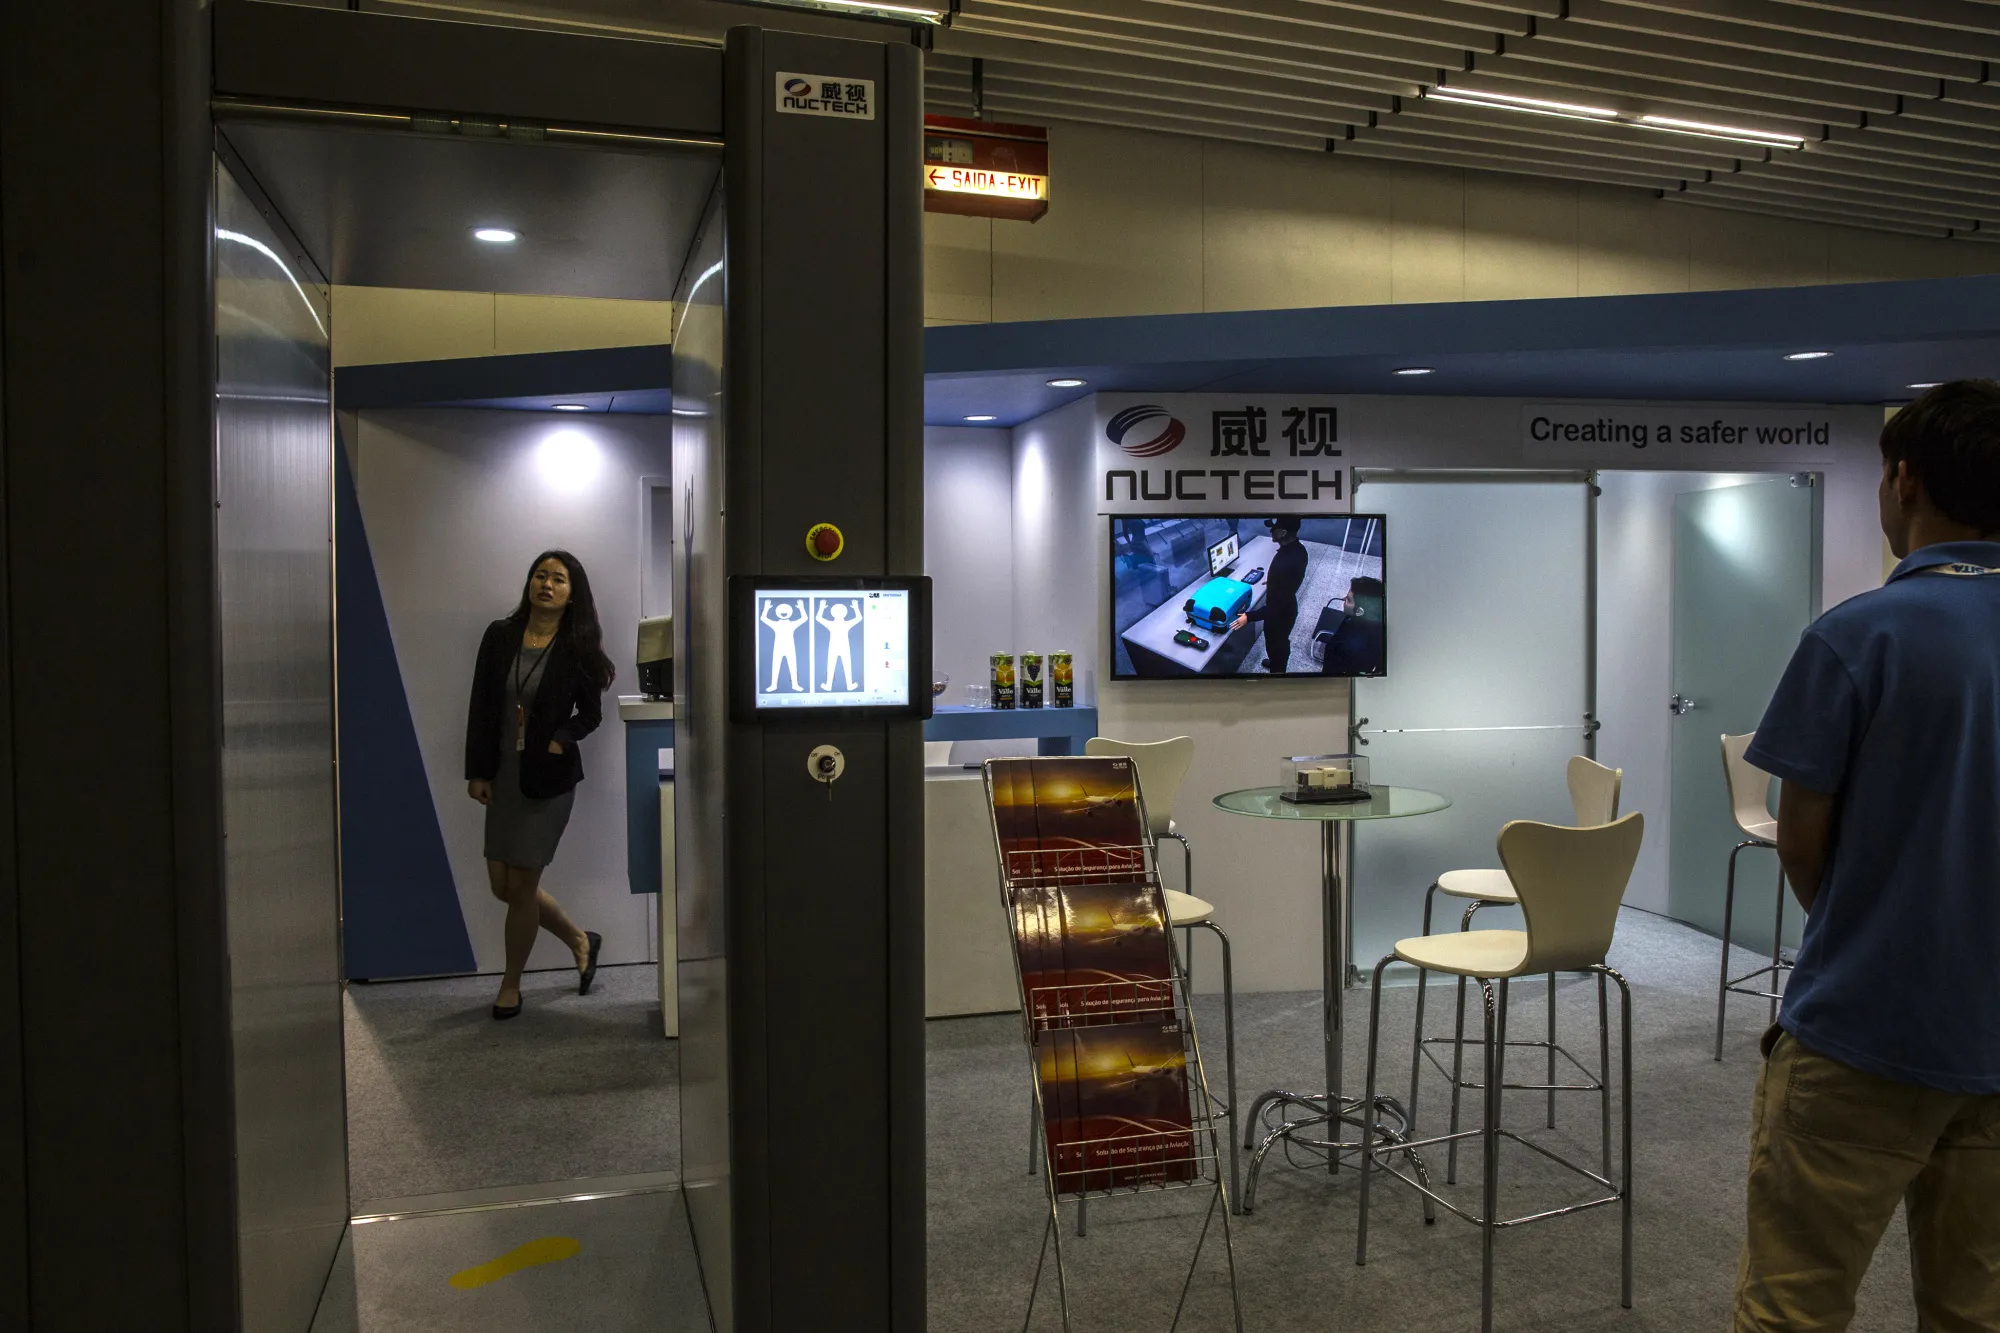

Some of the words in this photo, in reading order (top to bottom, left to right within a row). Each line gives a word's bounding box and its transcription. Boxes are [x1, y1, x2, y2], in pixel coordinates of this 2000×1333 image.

[820, 82, 867, 102] 威视
[783, 96, 868, 115] NUCTECH
[1008, 175, 1041, 195] EXIT
[1210, 405, 1343, 457] 威视
[1530, 416, 1648, 449] Creating
[1656, 425, 1672, 443] a
[1680, 420, 1749, 445] safer
[1756, 421, 1830, 446] world
[1105, 469, 1343, 501] NUCTECH
[1054, 865, 1074, 873] Slução
[1080, 999, 1101, 1007] Slução
[1096, 1148, 1118, 1157] Soluão
[1156, 1143, 1169, 1152] paa
